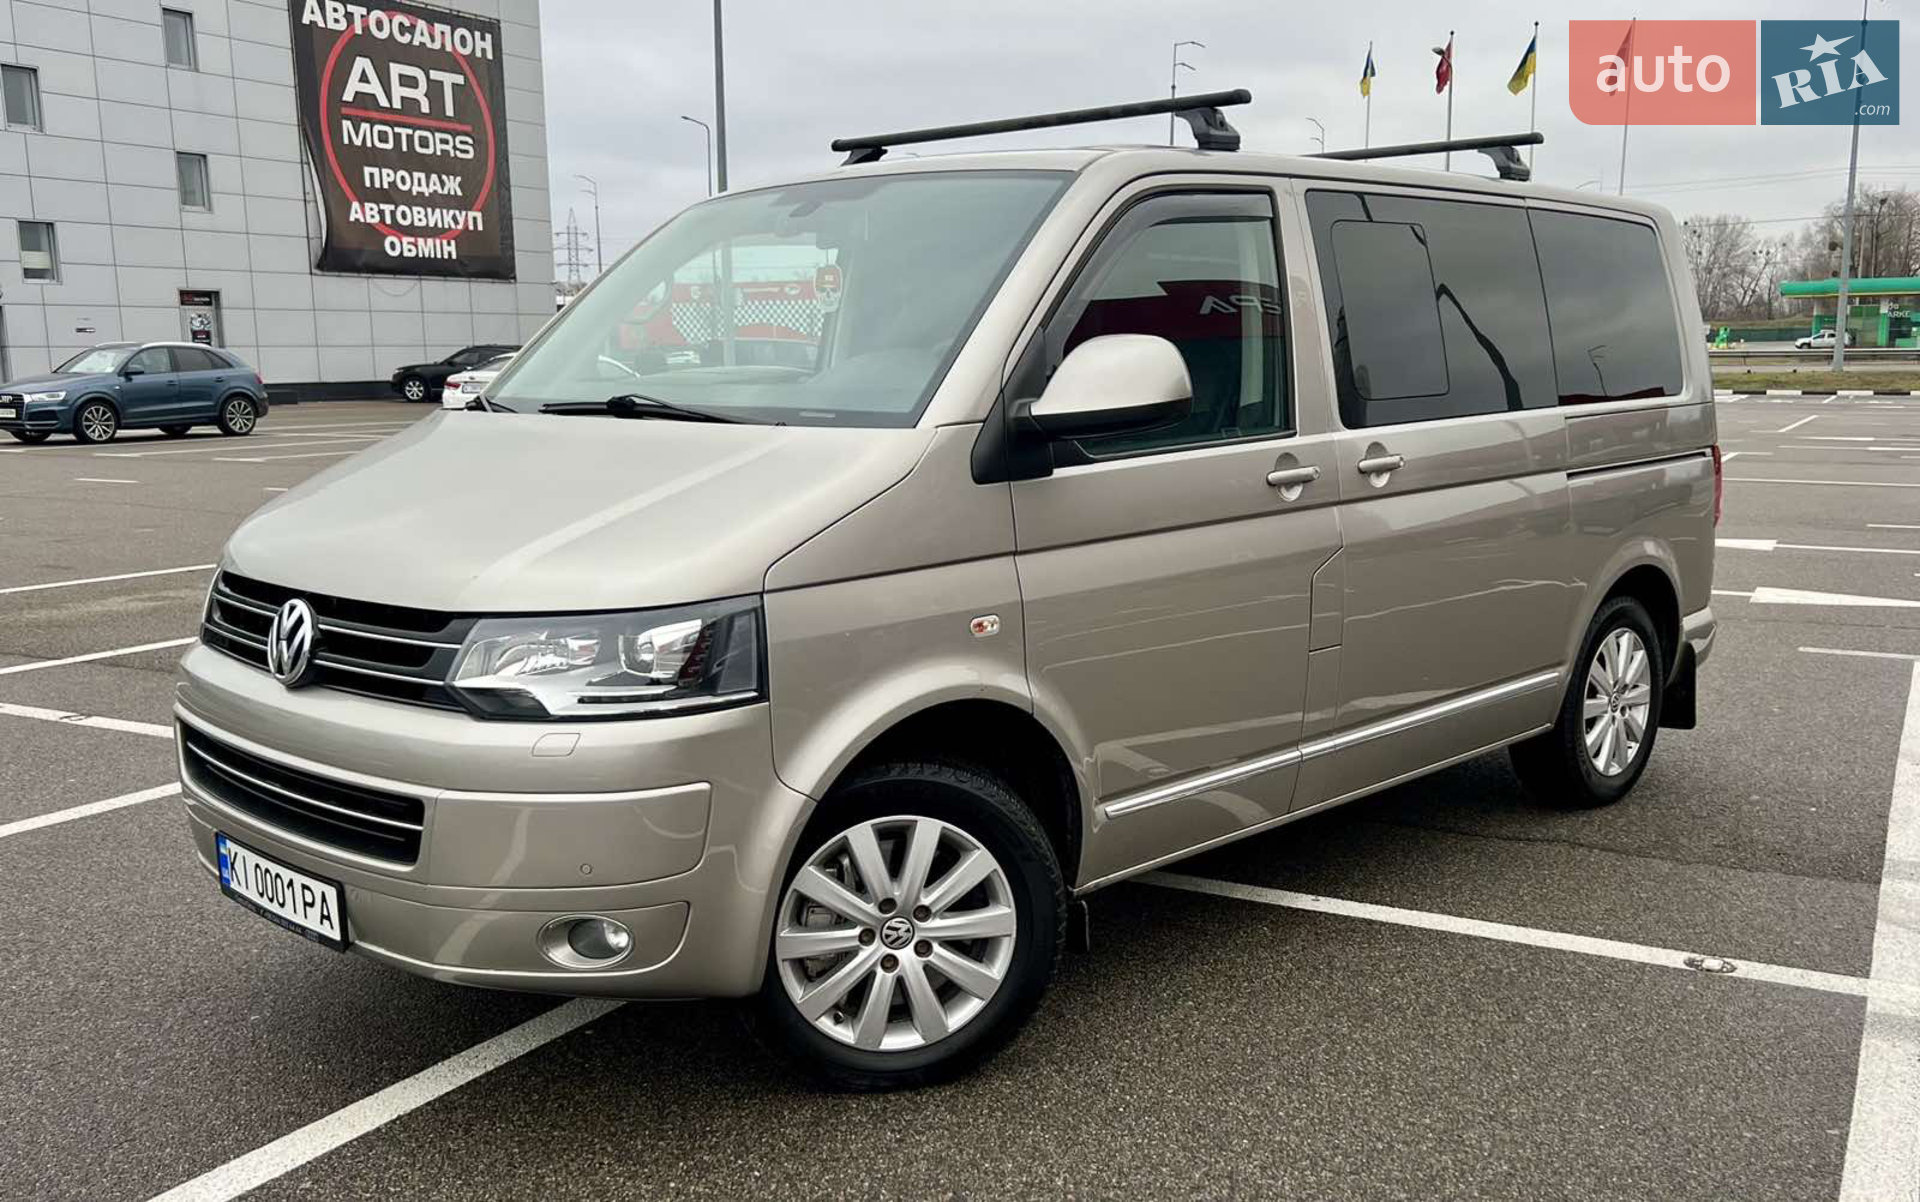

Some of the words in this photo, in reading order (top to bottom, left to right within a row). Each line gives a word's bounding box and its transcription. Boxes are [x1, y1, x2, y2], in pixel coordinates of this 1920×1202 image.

[302, 0, 494, 60] АВТОСАЛОН
[341, 56, 465, 117] ART
[341, 119, 475, 160] MOTORS
[363, 166, 463, 197] ПРОДАЖ
[349, 201, 484, 231] АВТОВИКУП
[383, 236, 457, 260] ОБМІН
[228, 848, 249, 890] KI
[254, 862, 297, 915] 0001
[301, 882, 335, 930] PA
